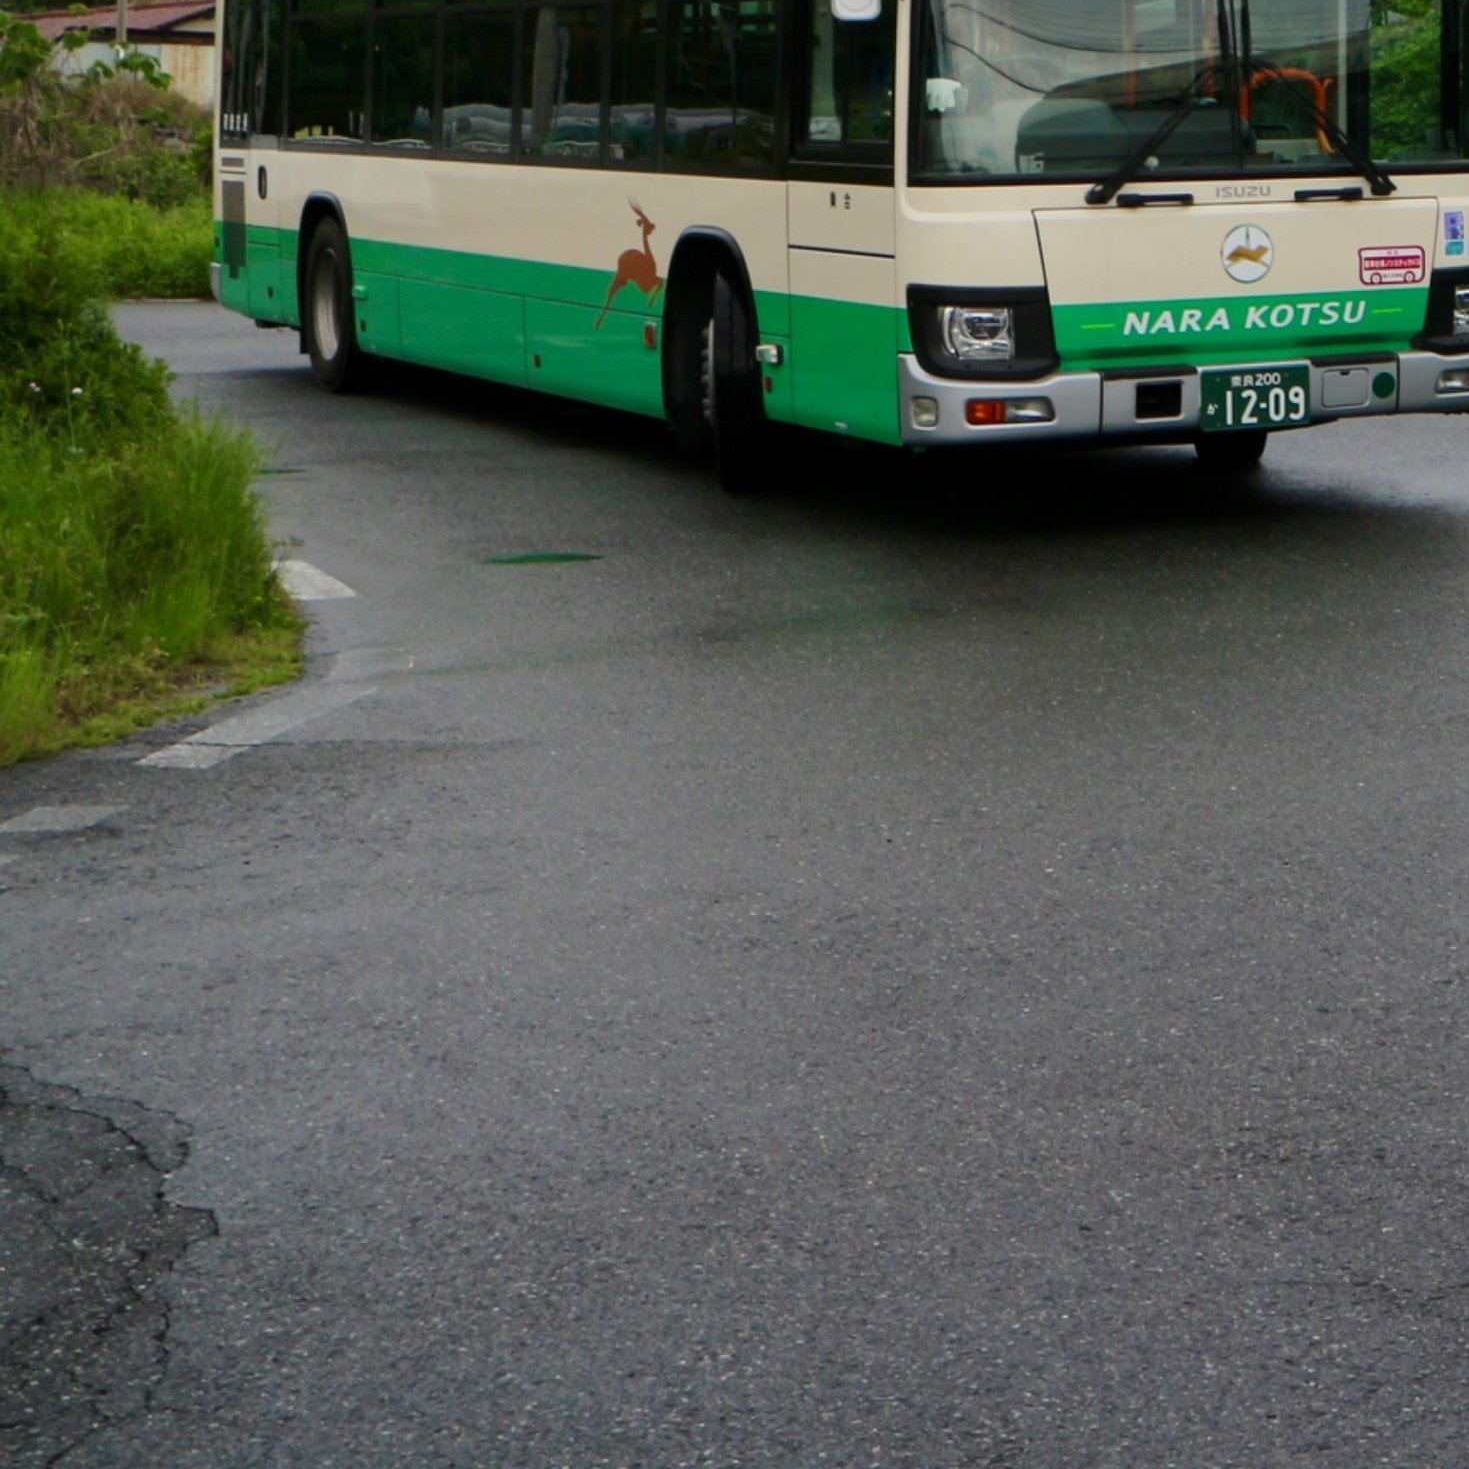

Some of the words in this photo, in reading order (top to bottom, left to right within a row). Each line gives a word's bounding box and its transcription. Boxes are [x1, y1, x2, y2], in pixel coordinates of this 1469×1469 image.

[1215, 185, 1271, 198] ISUZU
[1123, 307, 1230, 336] NARA
[1245, 300, 1366, 329] KOTSU
[1225, 386, 1305, 425] 12-09
